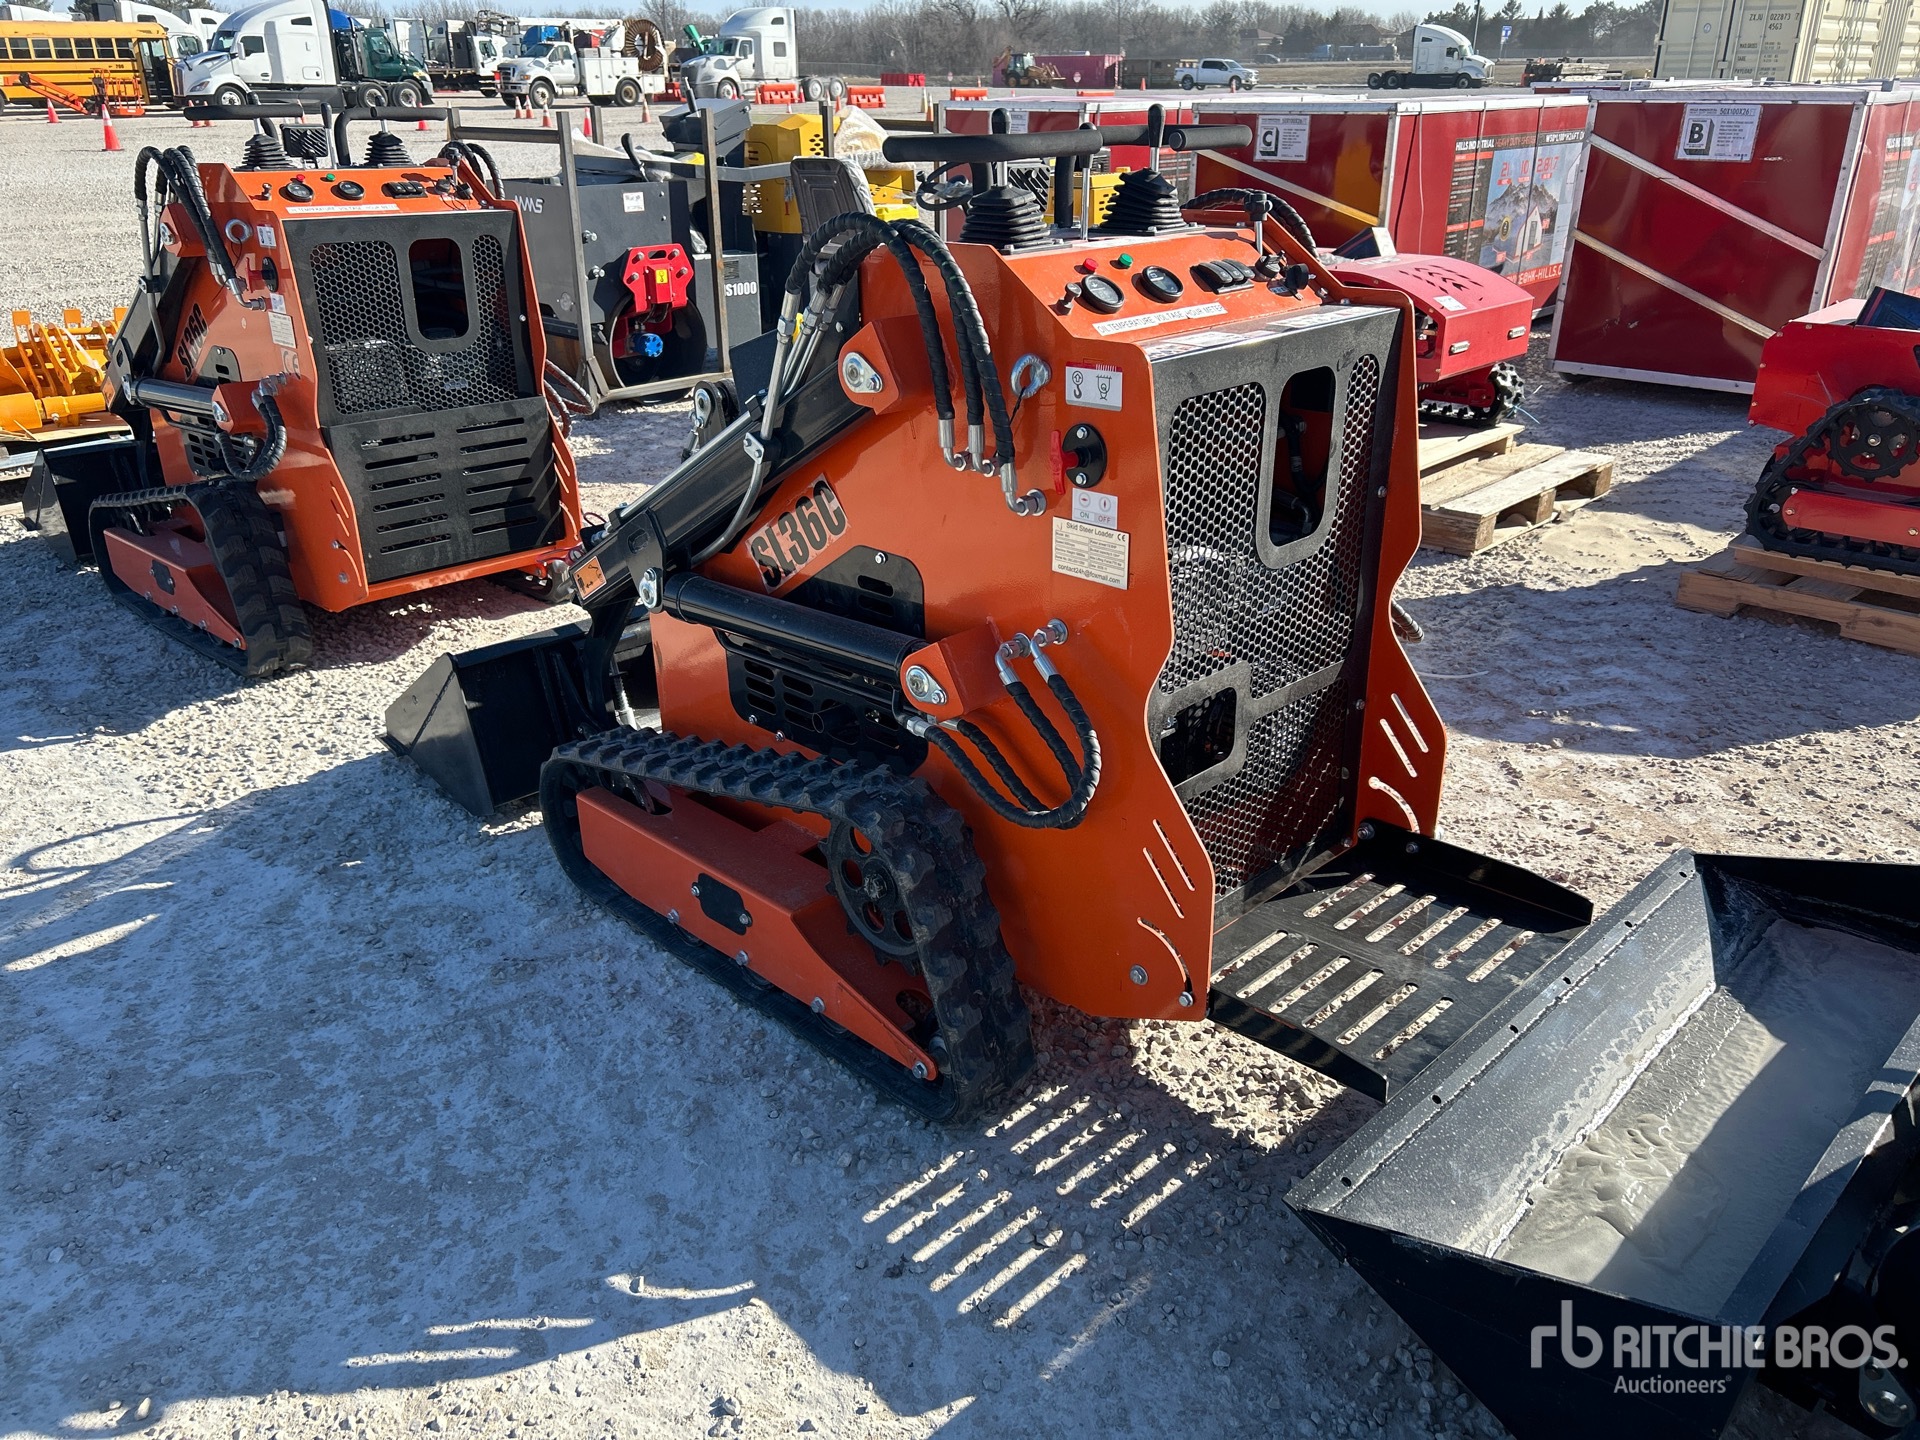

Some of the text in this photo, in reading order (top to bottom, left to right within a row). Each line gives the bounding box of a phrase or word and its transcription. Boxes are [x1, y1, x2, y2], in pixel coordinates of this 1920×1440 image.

[1749, 13, 1764, 21] ZXJU
[1770, 13, 1791, 21] 022873
[1262, 130, 1273, 147] C
[1688, 123, 1704, 143] B
[723, 281, 757, 297] S1000
[1154, 310, 1185, 321] VOLTAGE
[1186, 308, 1203, 318] HOUR
[178, 303, 208, 379] SL36C
[1080, 511, 1111, 523] ON OFF
[751, 480, 846, 587] SL36C
[1066, 521, 1078, 532] Skid
[1079, 525, 1094, 535] Steer
[1094, 529, 1114, 539] Loader
